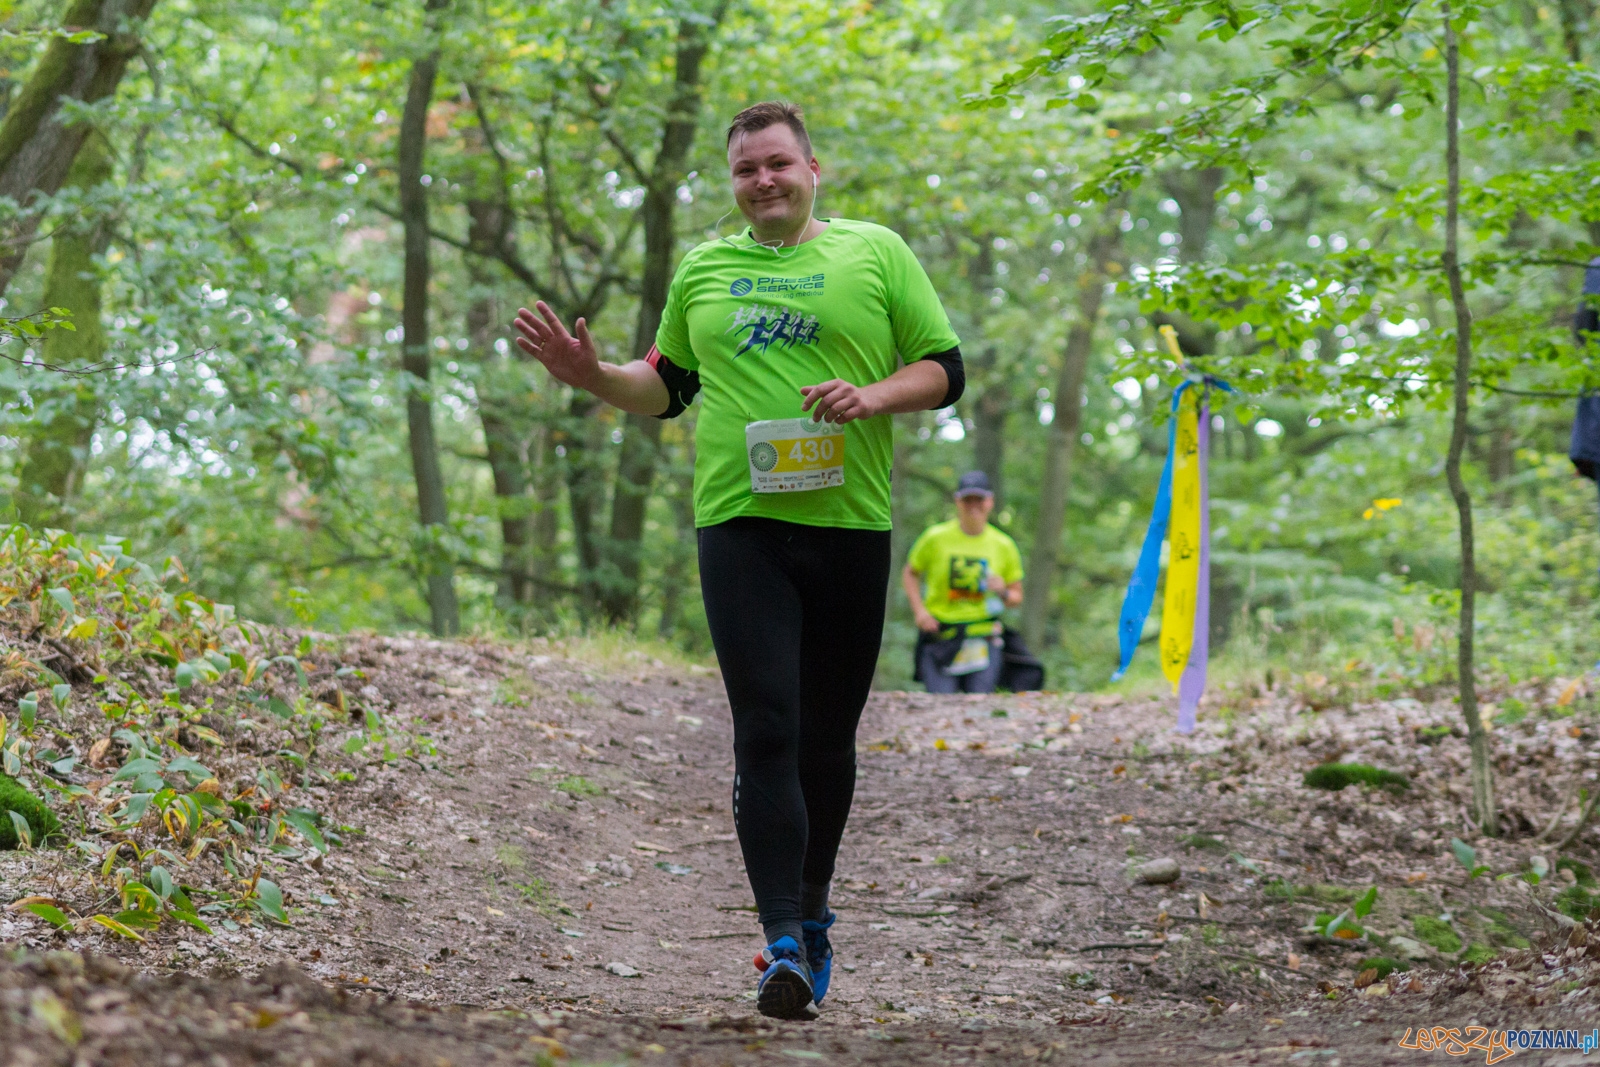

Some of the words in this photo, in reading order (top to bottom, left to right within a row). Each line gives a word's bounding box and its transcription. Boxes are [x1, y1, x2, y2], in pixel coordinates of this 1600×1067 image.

[757, 273, 825, 285] PRESS
[756, 281, 825, 293] SERVICE
[788, 438, 835, 463] 430
